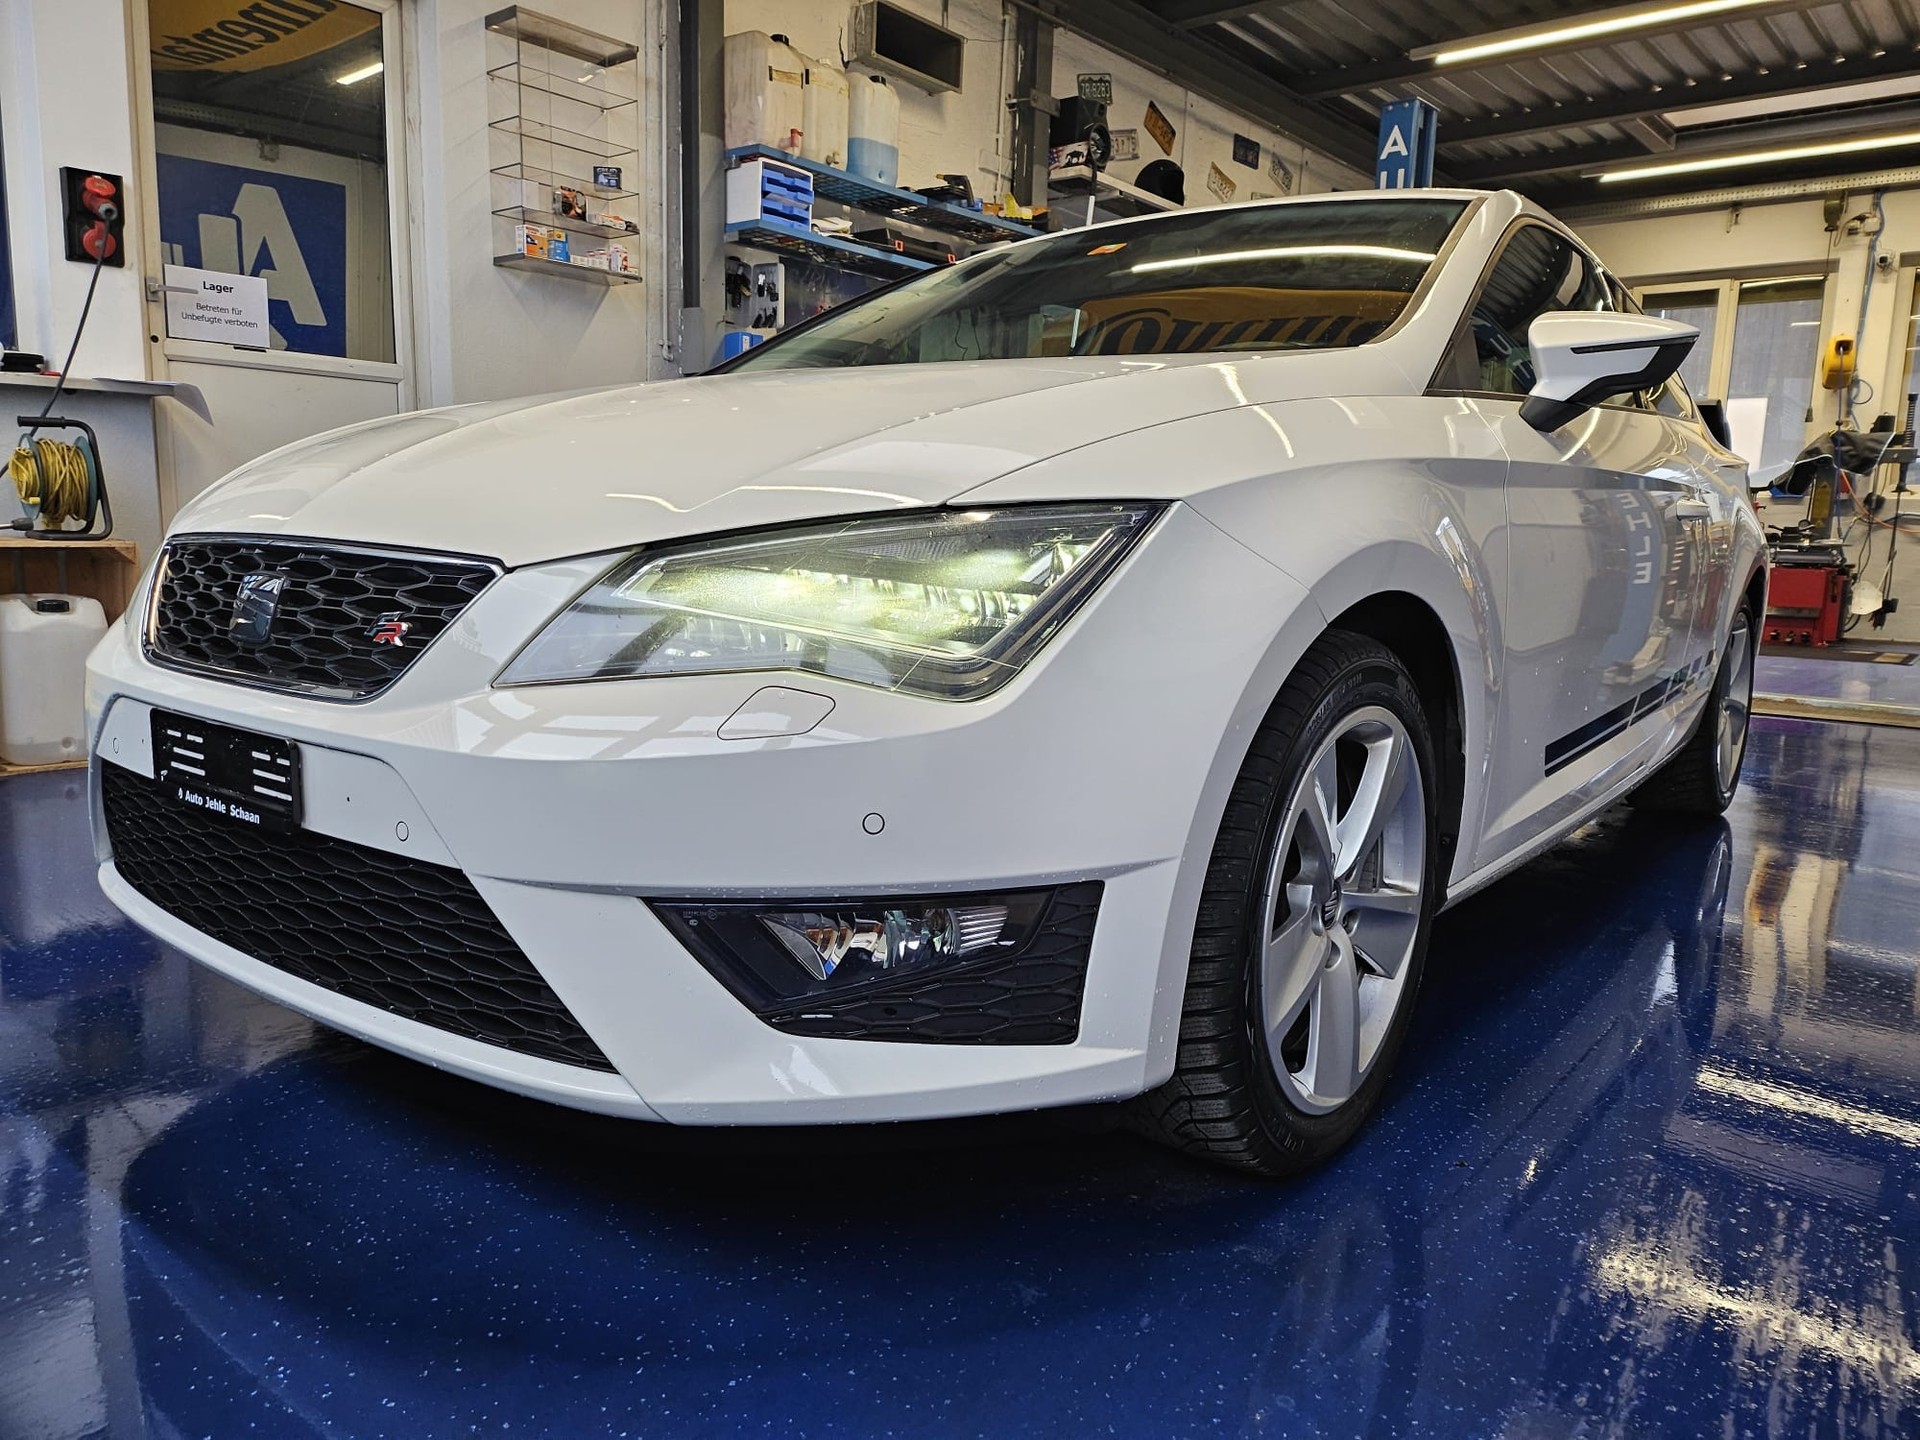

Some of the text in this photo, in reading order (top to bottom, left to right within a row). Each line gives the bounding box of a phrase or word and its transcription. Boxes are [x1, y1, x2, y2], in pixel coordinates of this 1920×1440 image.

[203, 281, 234, 293] Lager
[196, 303, 243, 315] Betreten für
[181, 312, 258, 328] Unbefugte verboten
[185, 790, 260, 824] Auto Jehle Schaan
